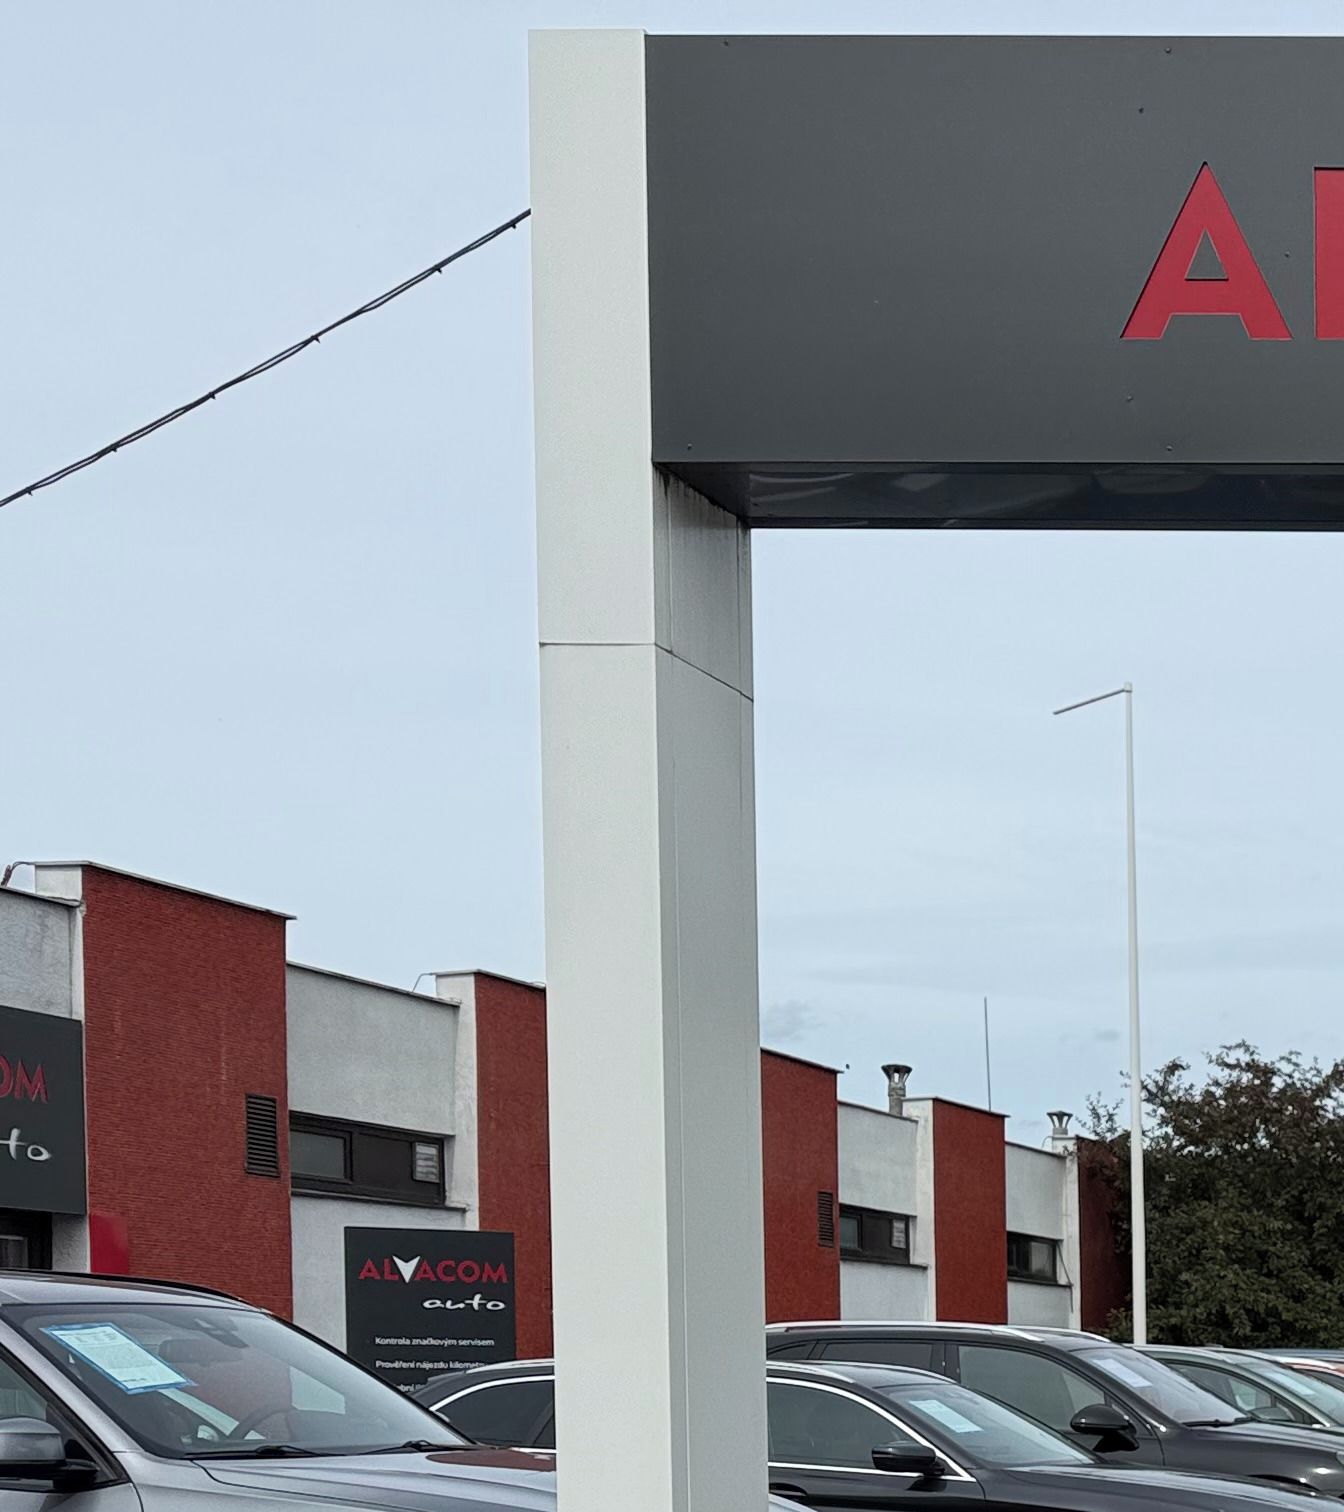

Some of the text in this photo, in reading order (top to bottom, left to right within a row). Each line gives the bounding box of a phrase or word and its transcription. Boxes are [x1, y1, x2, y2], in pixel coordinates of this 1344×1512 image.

[358, 1255, 508, 1284] ALVACOM
[422, 1293, 506, 1311] auto
[375, 1336, 411, 1345] Kontrola
[458, 1338, 495, 1346] servisem
